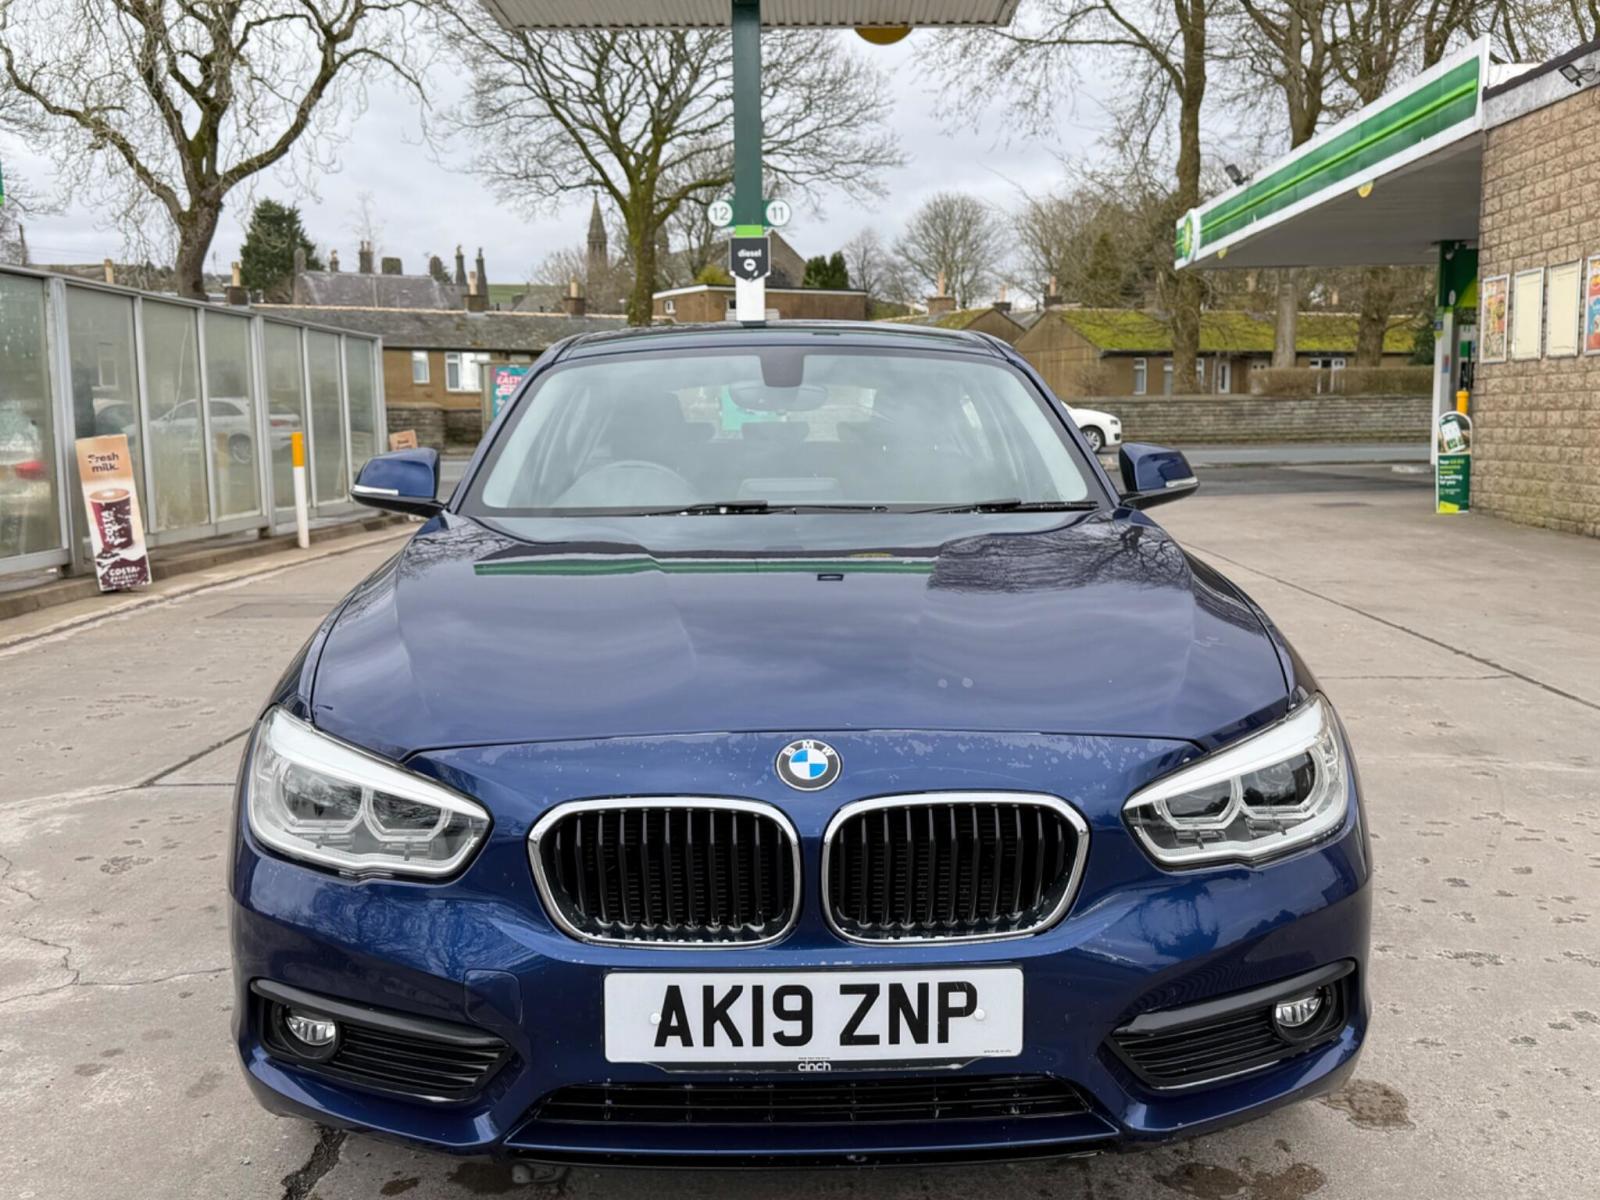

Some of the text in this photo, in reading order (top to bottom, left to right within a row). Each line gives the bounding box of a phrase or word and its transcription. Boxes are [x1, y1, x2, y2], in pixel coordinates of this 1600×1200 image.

[712, 207, 728, 221] 12
[771, 207, 784, 221] 11
[737, 249, 762, 258] diesel
[87, 453, 119, 464] Fresh
[109, 566, 137, 577] COSTA
[782, 740, 835, 756] BMW
[654, 981, 978, 1047] AK19 ZNP
[798, 1061, 831, 1072] cinch
